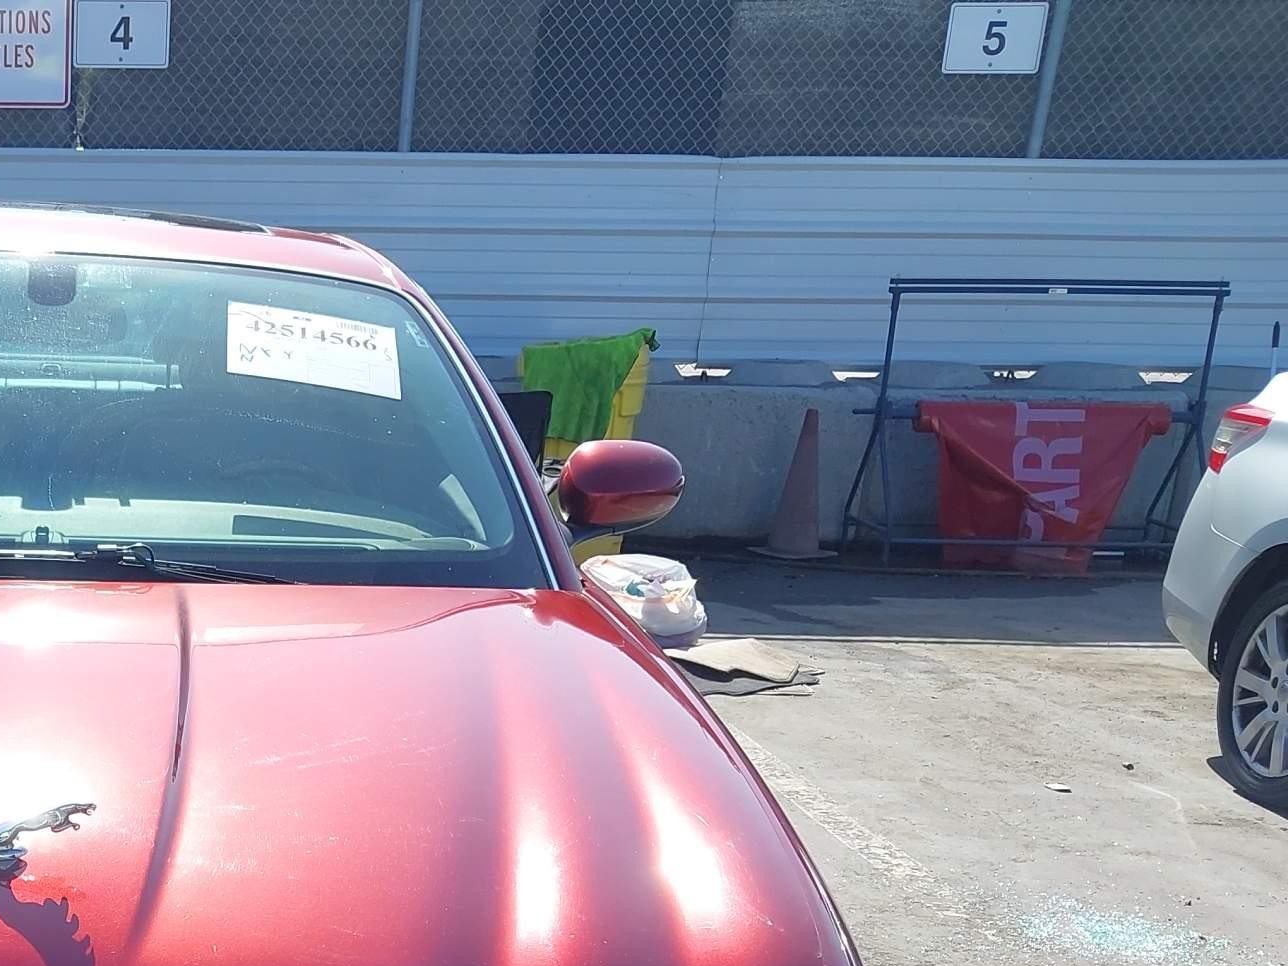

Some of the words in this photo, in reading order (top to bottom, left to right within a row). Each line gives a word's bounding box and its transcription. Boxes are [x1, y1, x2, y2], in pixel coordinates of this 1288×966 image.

[109, 16, 134, 51] 4
[982, 20, 1008, 56] 5
[245, 319, 377, 351] 42514566
